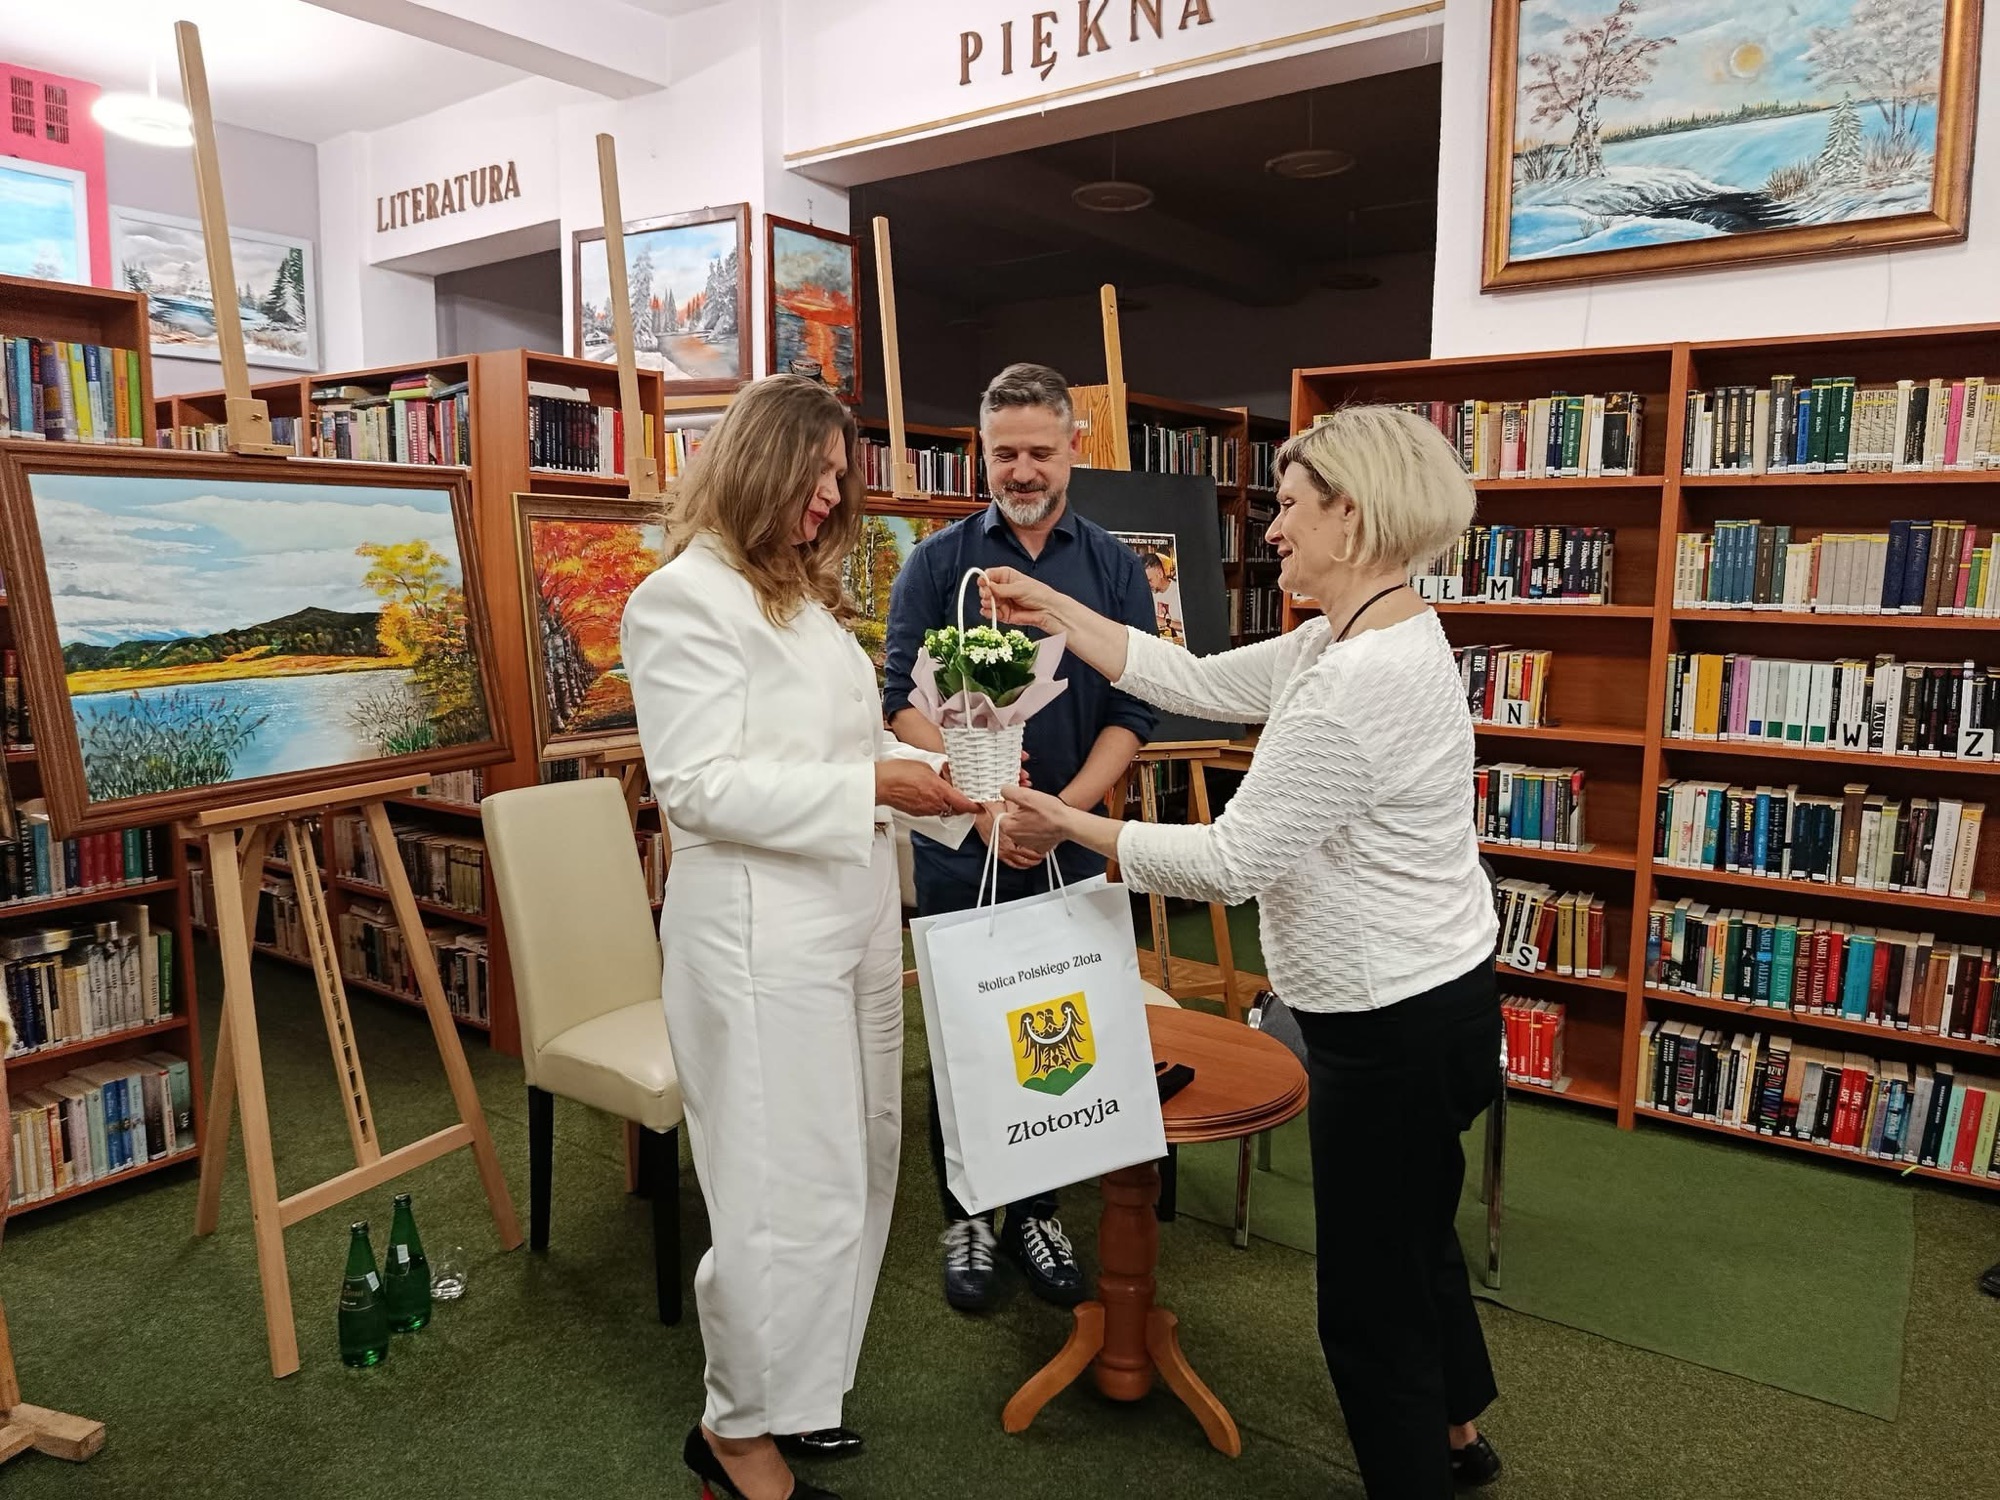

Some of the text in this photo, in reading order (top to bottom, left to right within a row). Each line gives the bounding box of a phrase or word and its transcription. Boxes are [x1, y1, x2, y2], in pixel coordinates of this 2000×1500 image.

[959, 0, 1213, 86] PIĘKNA
[377, 161, 521, 233] LITERATURA
[1533, 528, 1544, 560] MARININA
[1548, 528, 1560, 560] MARININA
[1563, 540, 1572, 570] MARININA
[1580, 540, 1589, 570] MARININA
[1590, 540, 1600, 570] MARININA
[1419, 578, 1431, 599] L
[1442, 579, 1456, 600] Ł
[1489, 579, 1509, 600] M
[1507, 703, 1522, 724] N
[1872, 702, 1886, 739] LAUR
[1843, 723, 1862, 747] W
[1964, 731, 1986, 757] Z
[1730, 800, 1740, 828] Ahern
[1744, 802, 1754, 832] Ahern
[1517, 946, 1533, 966] S
[1756, 928, 1772, 996] SABEL ALLENDE
[1774, 932, 1791, 1000] SABEL ALLENDE
[1795, 934, 1810, 1002] SABEL ALLENDE
[978, 975, 1016, 994] Stolica
[1018, 962, 1070, 983] Polskiego
[1811, 972, 1825, 1006] ALLENDE
[1007, 1098, 1120, 1145] Złotoryja
